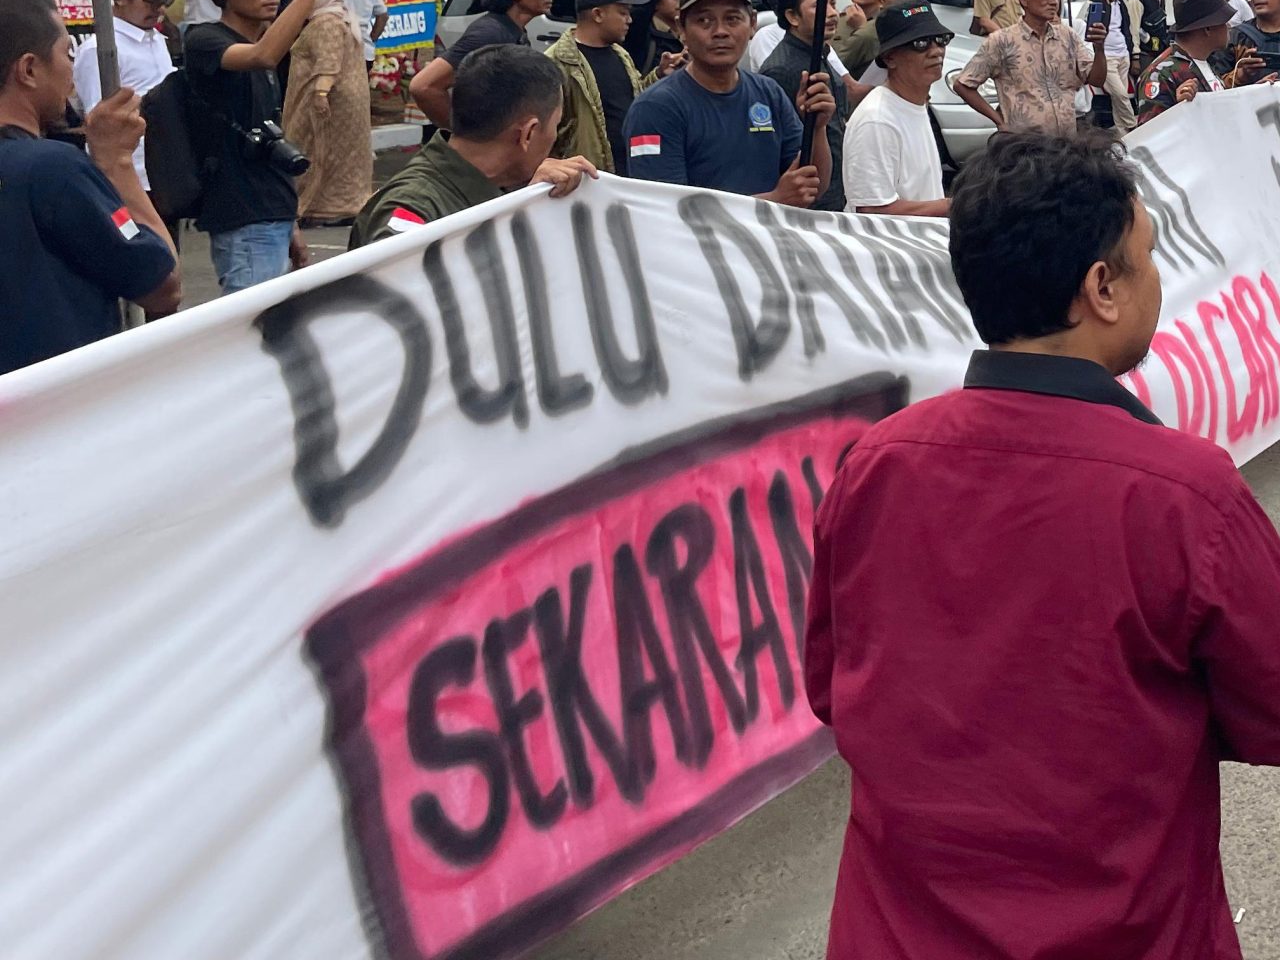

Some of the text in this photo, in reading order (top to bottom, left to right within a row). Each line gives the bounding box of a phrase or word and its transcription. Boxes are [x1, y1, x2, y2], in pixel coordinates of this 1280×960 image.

[254, 199, 670, 529] DULU
[677, 192, 974, 382] DATAN
[407, 444, 848, 871] SEKARAN
